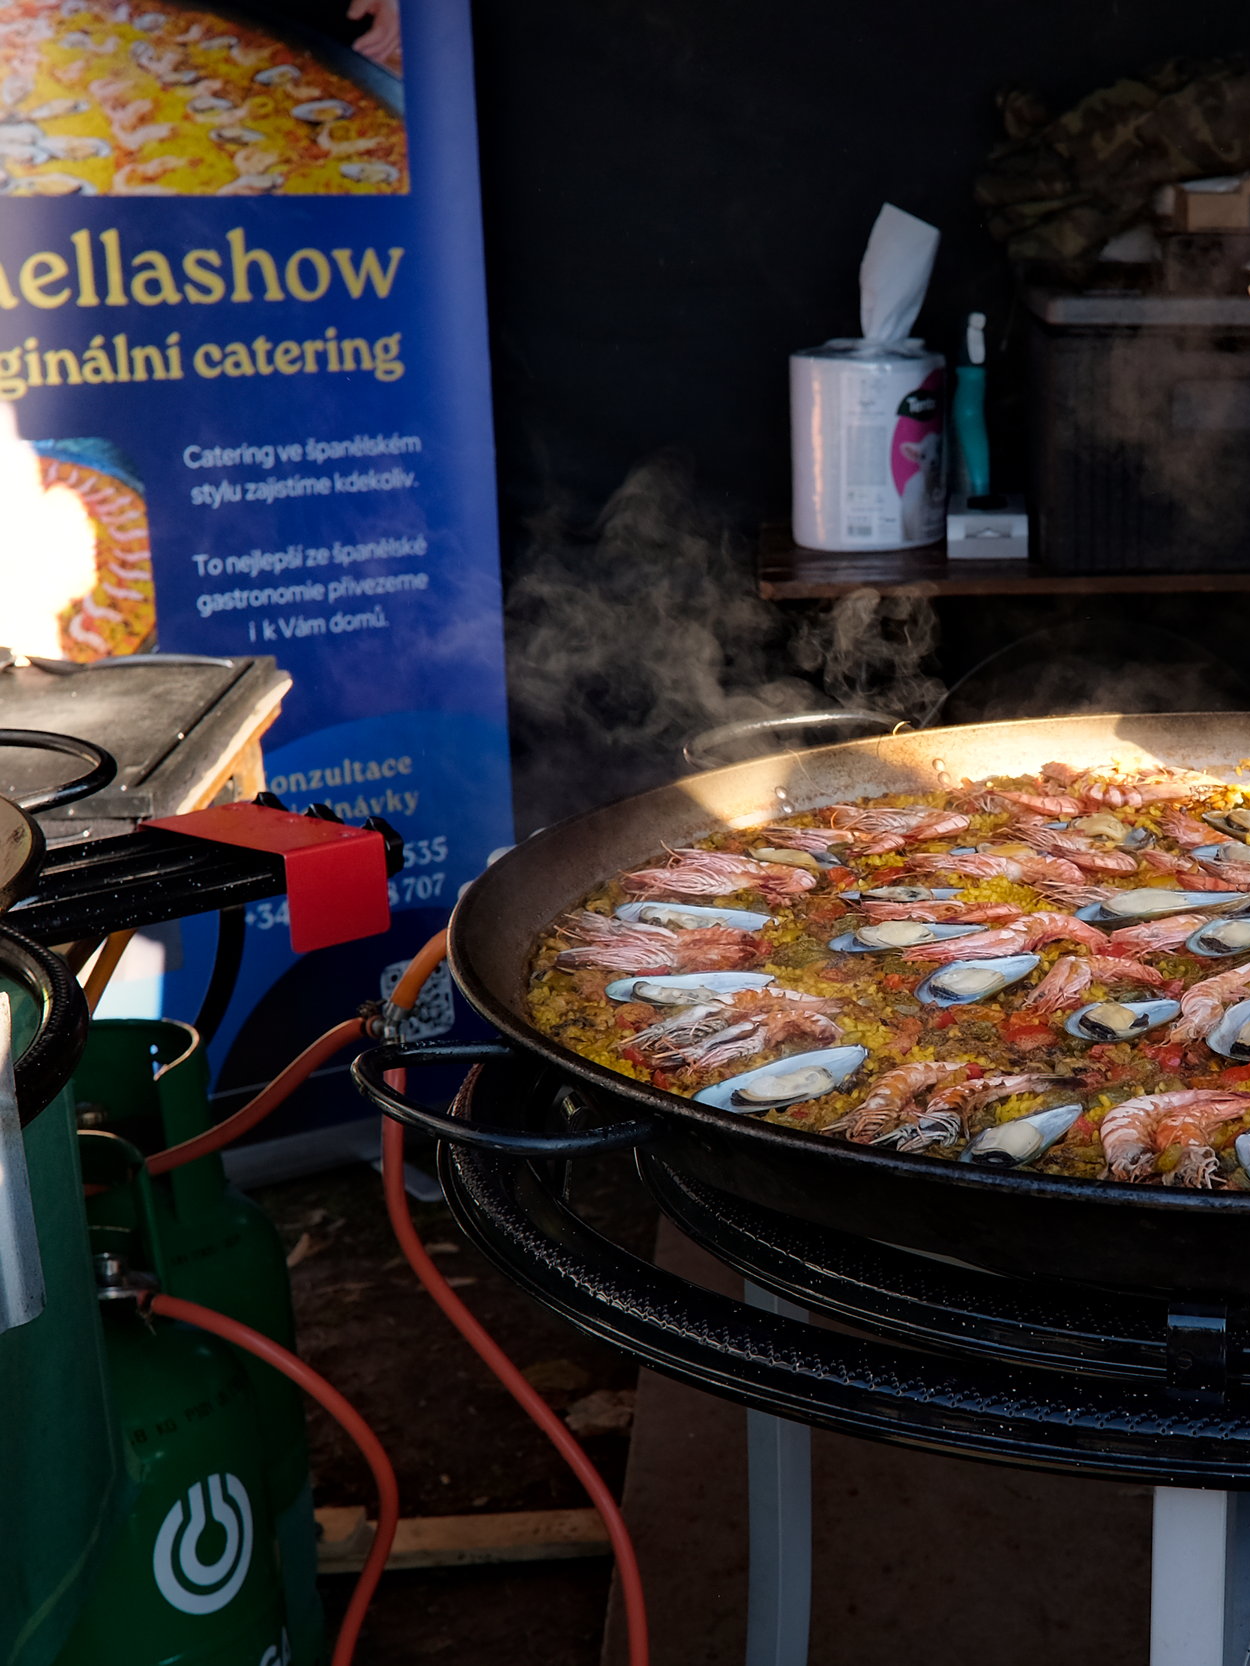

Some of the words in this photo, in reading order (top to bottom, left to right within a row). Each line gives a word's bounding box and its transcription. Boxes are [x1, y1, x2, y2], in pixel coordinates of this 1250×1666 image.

[193, 327, 406, 382] catering
[183, 443, 275, 469] Catering
[277, 443, 304, 463] ve
[190, 479, 242, 509] stylu
[192, 554, 224, 577] To
[225, 545, 304, 577] nejlepší
[305, 547, 331, 567] ze
[332, 534, 428, 567] španělské
[196, 580, 325, 618] gastronomie
[263, 619, 277, 641] k
[278, 616, 326, 639] Vám
[266, 755, 413, 795] onzultace
[402, 835, 449, 868] 535
[402, 872, 446, 903] 707
